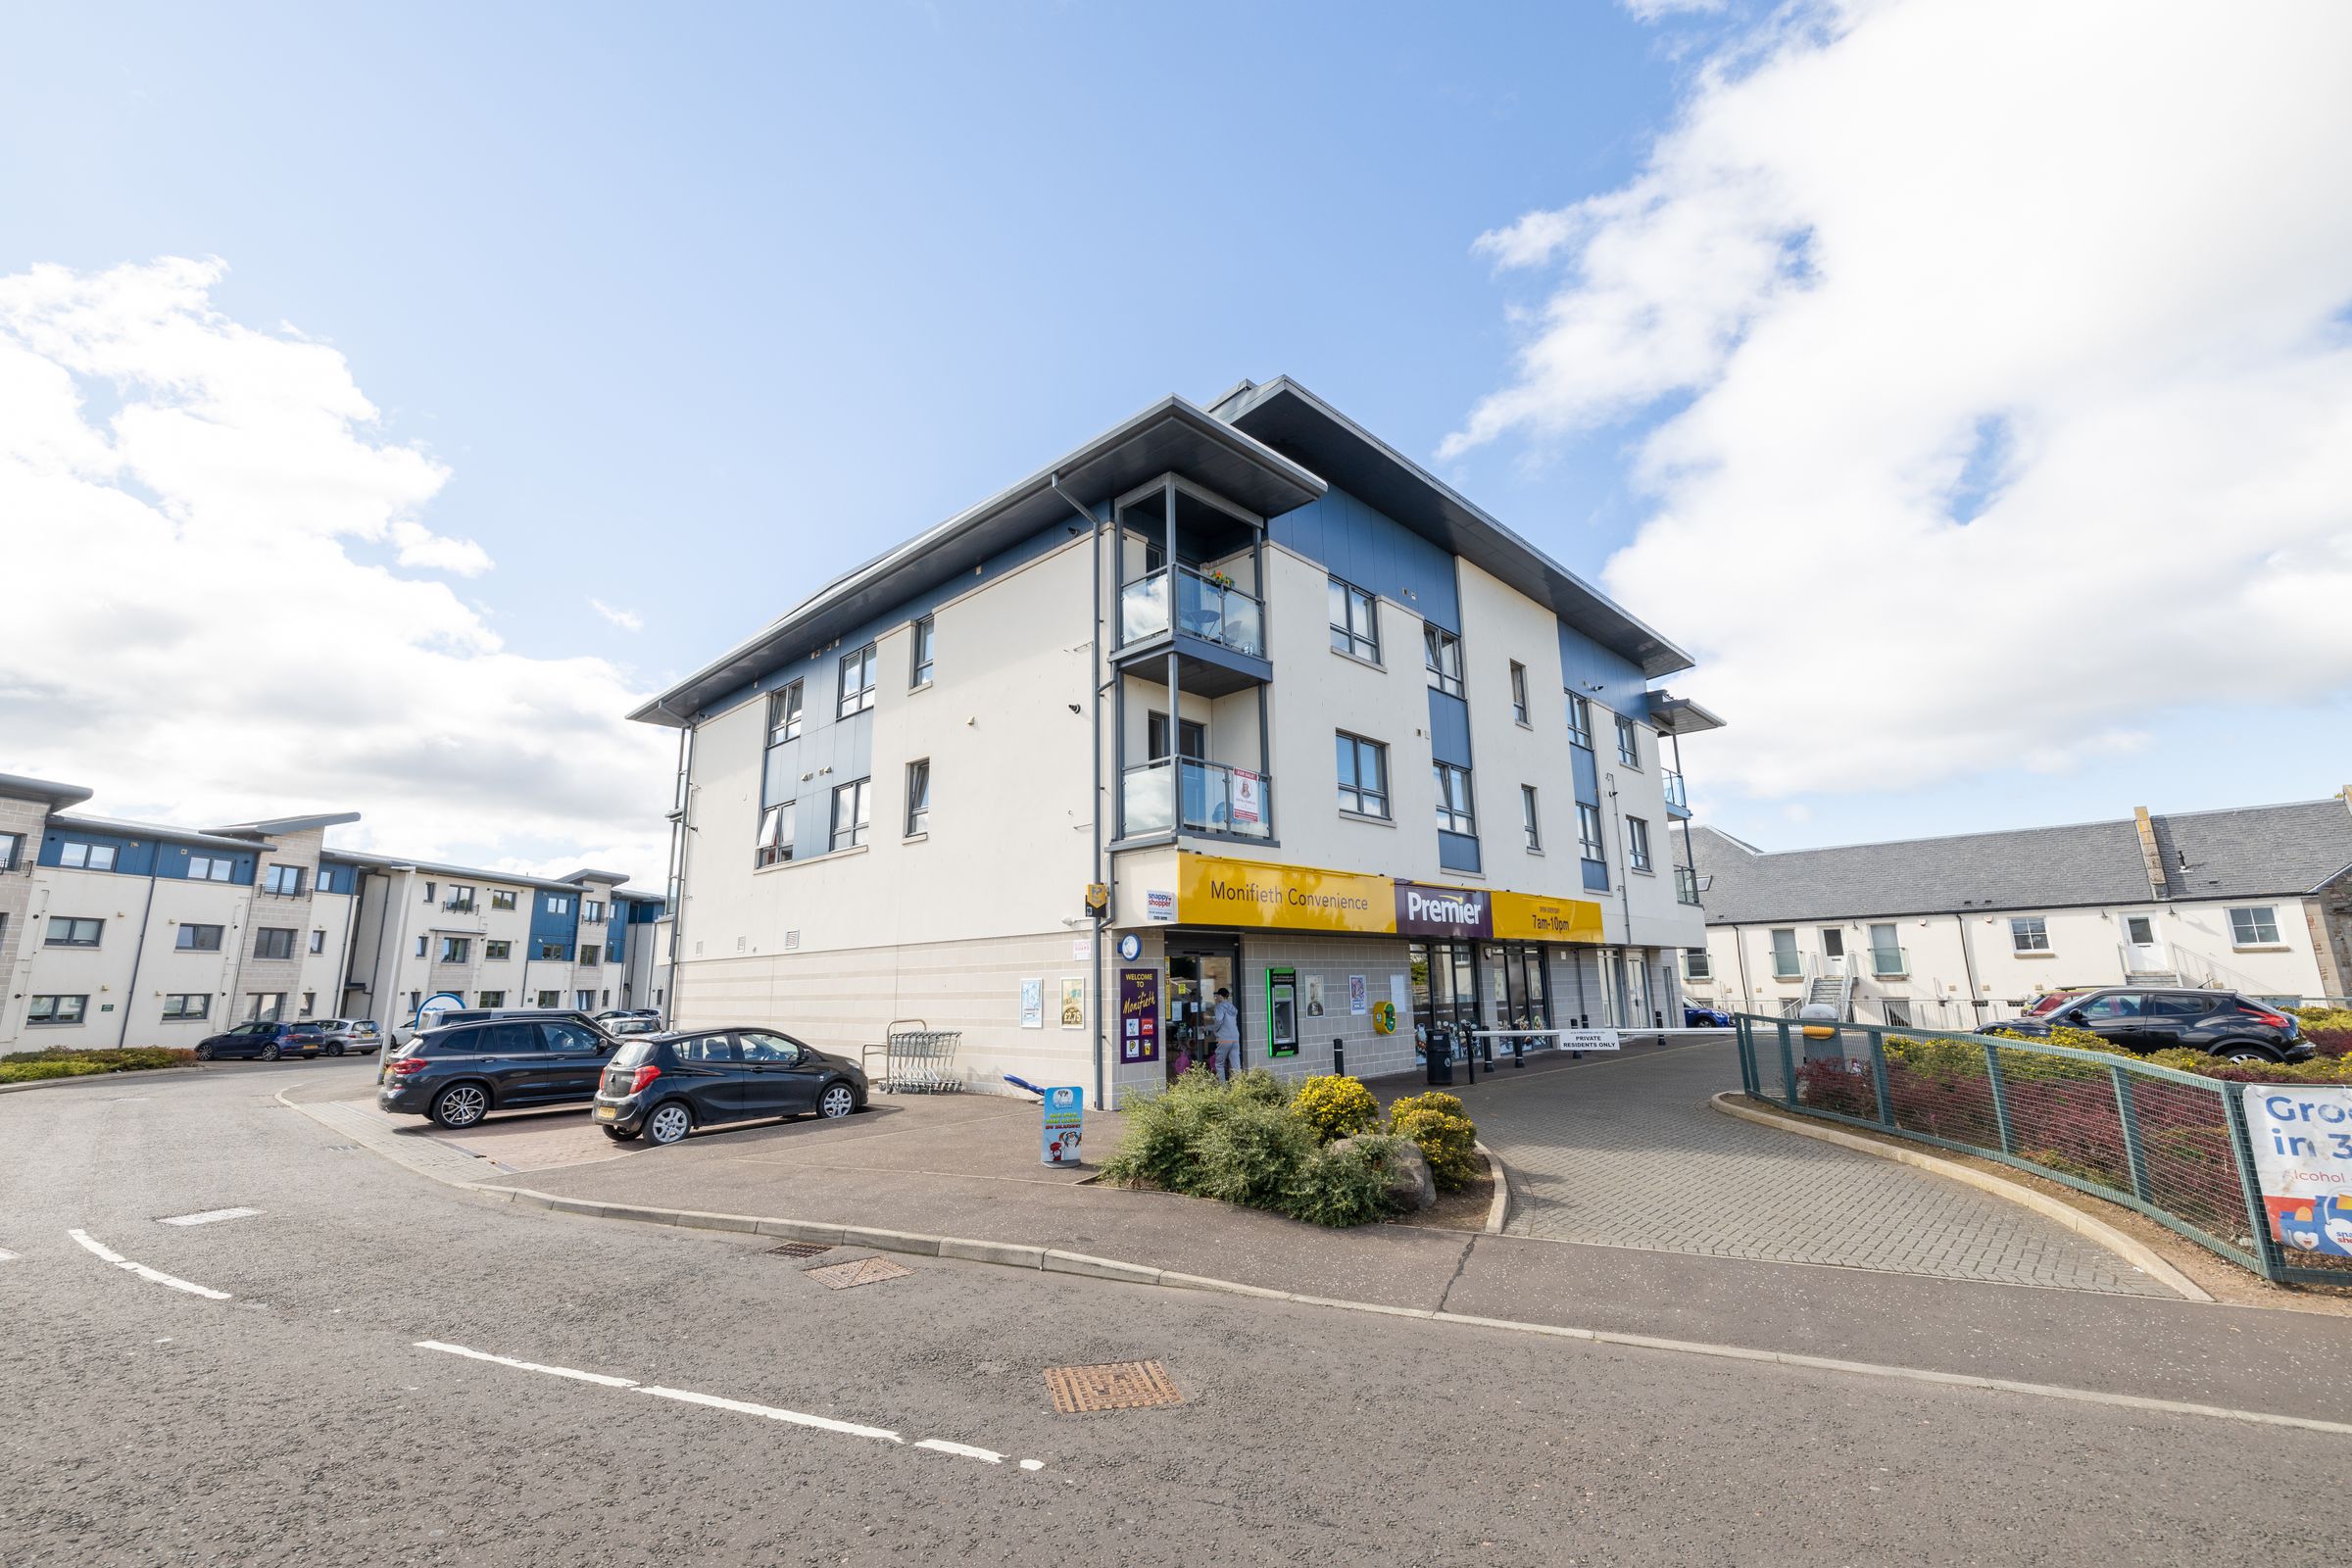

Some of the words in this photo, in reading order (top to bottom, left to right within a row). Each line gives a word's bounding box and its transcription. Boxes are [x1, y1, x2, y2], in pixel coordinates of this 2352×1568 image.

[1148, 893, 1169, 902] snappy
[1211, 880, 1283, 904] Monifieth
[1288, 888, 1368, 910] Convenience
[1407, 892, 1482, 925] Premier
[1532, 914, 1570, 933] 7am-10pm
[2266, 1096, 2352, 1123] Gro
[2272, 1128, 2318, 1157] in
[2282, 1168, 2345, 1183] Alcohol
